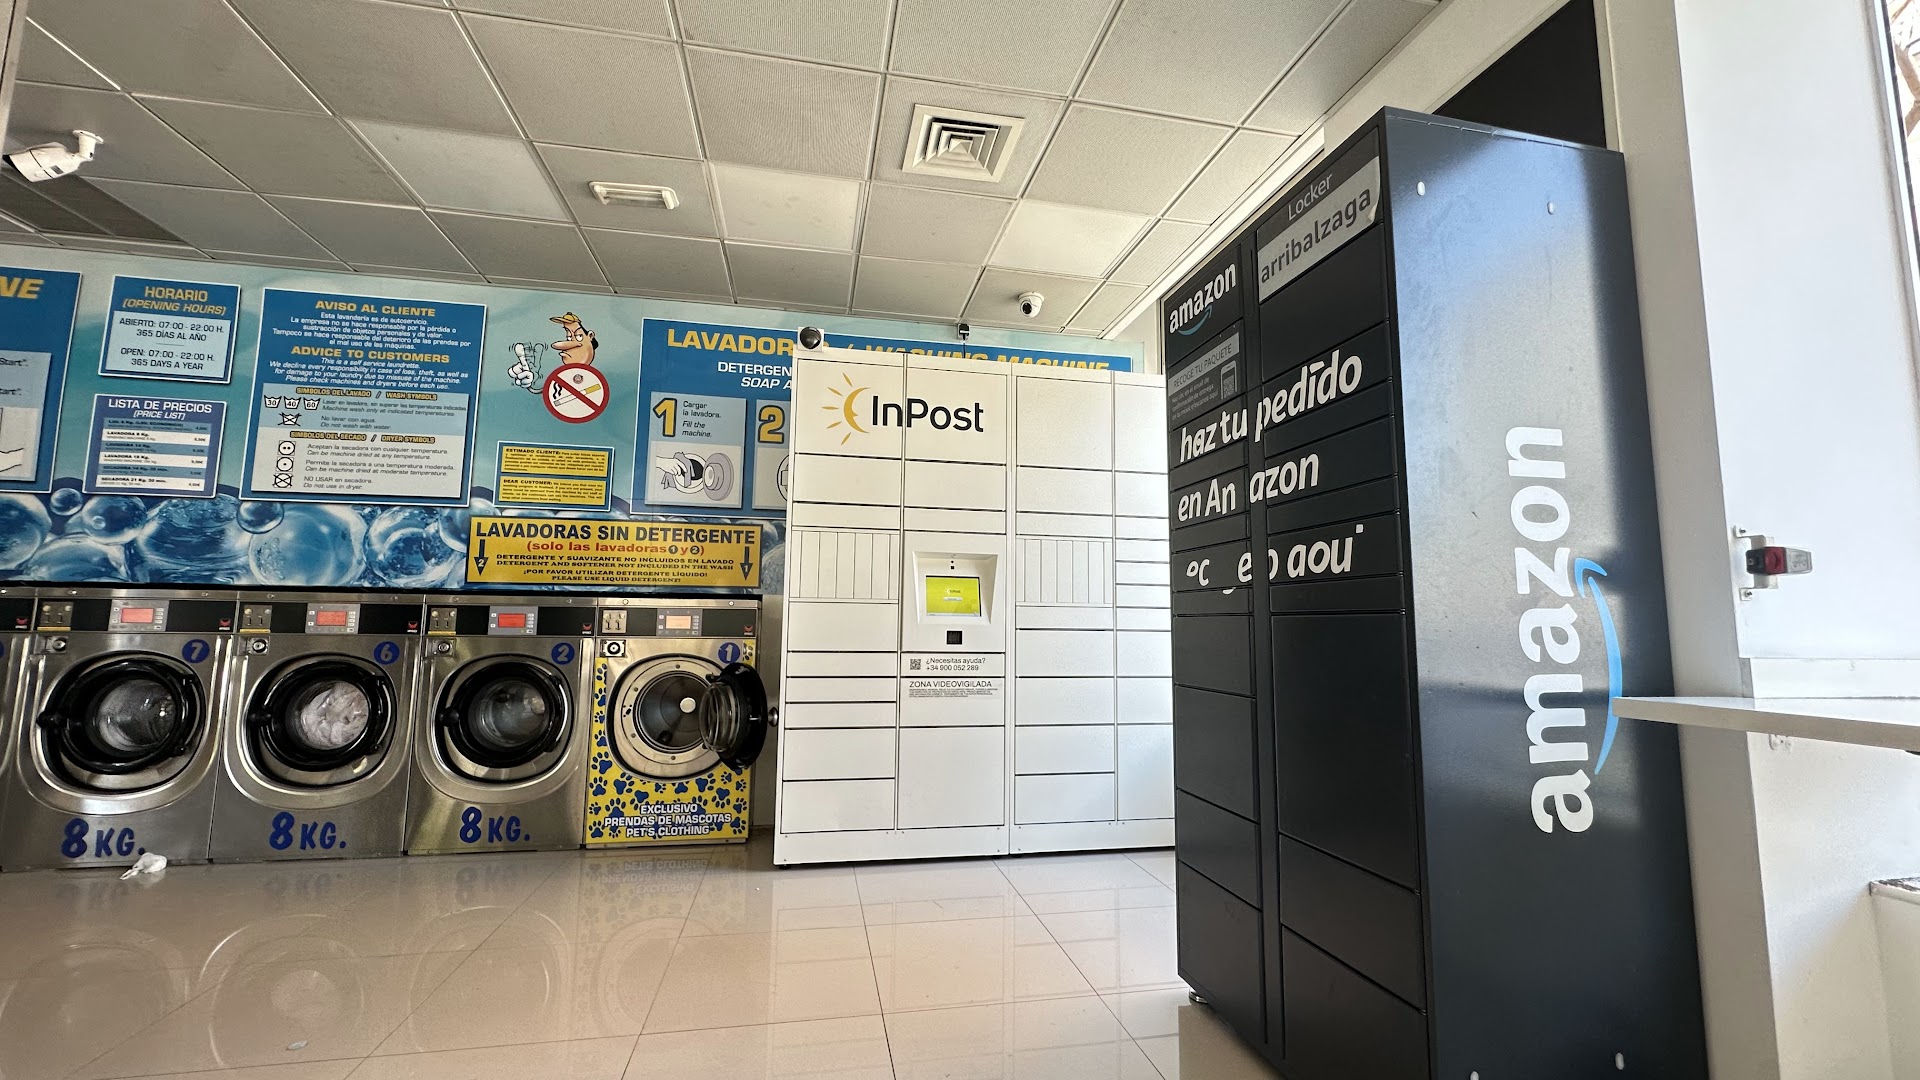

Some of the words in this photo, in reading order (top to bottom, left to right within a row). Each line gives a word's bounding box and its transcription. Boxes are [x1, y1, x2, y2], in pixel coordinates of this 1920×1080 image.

[1288, 172, 1333, 222] Locker
[1261, 189, 1371, 284] arribalzaga
[145, 286, 208, 302] HORARIO
[1169, 262, 1236, 334] amazon
[122, 298, 180, 311] (OPENING
[183, 303, 226, 316] HOURS)
[315, 300, 357, 311] AVISO
[361, 304, 378, 313] AL
[382, 306, 436, 317] CLIENTE
[120, 318, 156, 327] ABIERTO:
[159, 321, 184, 330] 07:00
[190, 324, 214, 332] 22:00
[136, 329, 153, 337] 365
[156, 330, 174, 338] DÍAS
[189, 332, 206, 341] AÑO
[668, 328, 795, 356] LAVADOR
[121, 348, 146, 356] OPEN:
[148, 350, 174, 358] 07:00
[180, 352, 204, 360] 22:00
[291, 346, 342, 357] ADVICE
[347, 349, 364, 358] TO
[368, 351, 450, 362] CUSTOMERS
[150, 360, 172, 368] DAYS
[183, 362, 204, 370] YEAR
[718, 362, 792, 376] DETERGEN
[1174, 368, 1194, 387] RECOGE
[1195, 363, 1203, 374] TU
[1204, 344, 1232, 370] PAQUETE
[741, 377, 780, 389] SOAP
[108, 398, 140, 409] LISTA
[144, 400, 160, 410] DE
[163, 402, 212, 413] PRECIOS
[682, 401, 708, 410] Cargar
[691, 410, 722, 418] lavadora.
[872, 395, 984, 433] InPost
[164, 412, 186, 420] LIST)
[653, 398, 677, 437] 1
[758, 404, 785, 444] 2
[682, 430, 712, 438] machine.
[1180, 421, 1218, 463] haz
[1220, 408, 1248, 444] tu
[1178, 492, 1200, 522] en
[476, 522, 591, 540] LAVADORAS
[598, 526, 628, 540] SIN
[636, 526, 755, 544] DETERGENTE
[527, 541, 564, 552] (solo
[568, 542, 590, 552] las
[596, 542, 666, 553] lavadoras
[680, 547, 688, 555] y
[1506, 426, 1594, 834] amazon
[556, 645, 570, 662] 2
[640, 804, 698, 815] EXCLUSIVO
[460, 806, 482, 843] 8
[488, 816, 530, 843] KG.
[604, 816, 655, 827] PRENDAS
[658, 815, 672, 825] DE
[675, 813, 732, 825] MASCOTAS
[61, 818, 90, 858] 8
[95, 827, 145, 858] KG.
[269, 812, 294, 850] 8
[300, 821, 346, 850] KG.
[626, 827, 656, 838] PET'S
[658, 826, 710, 837] CLOTHING
